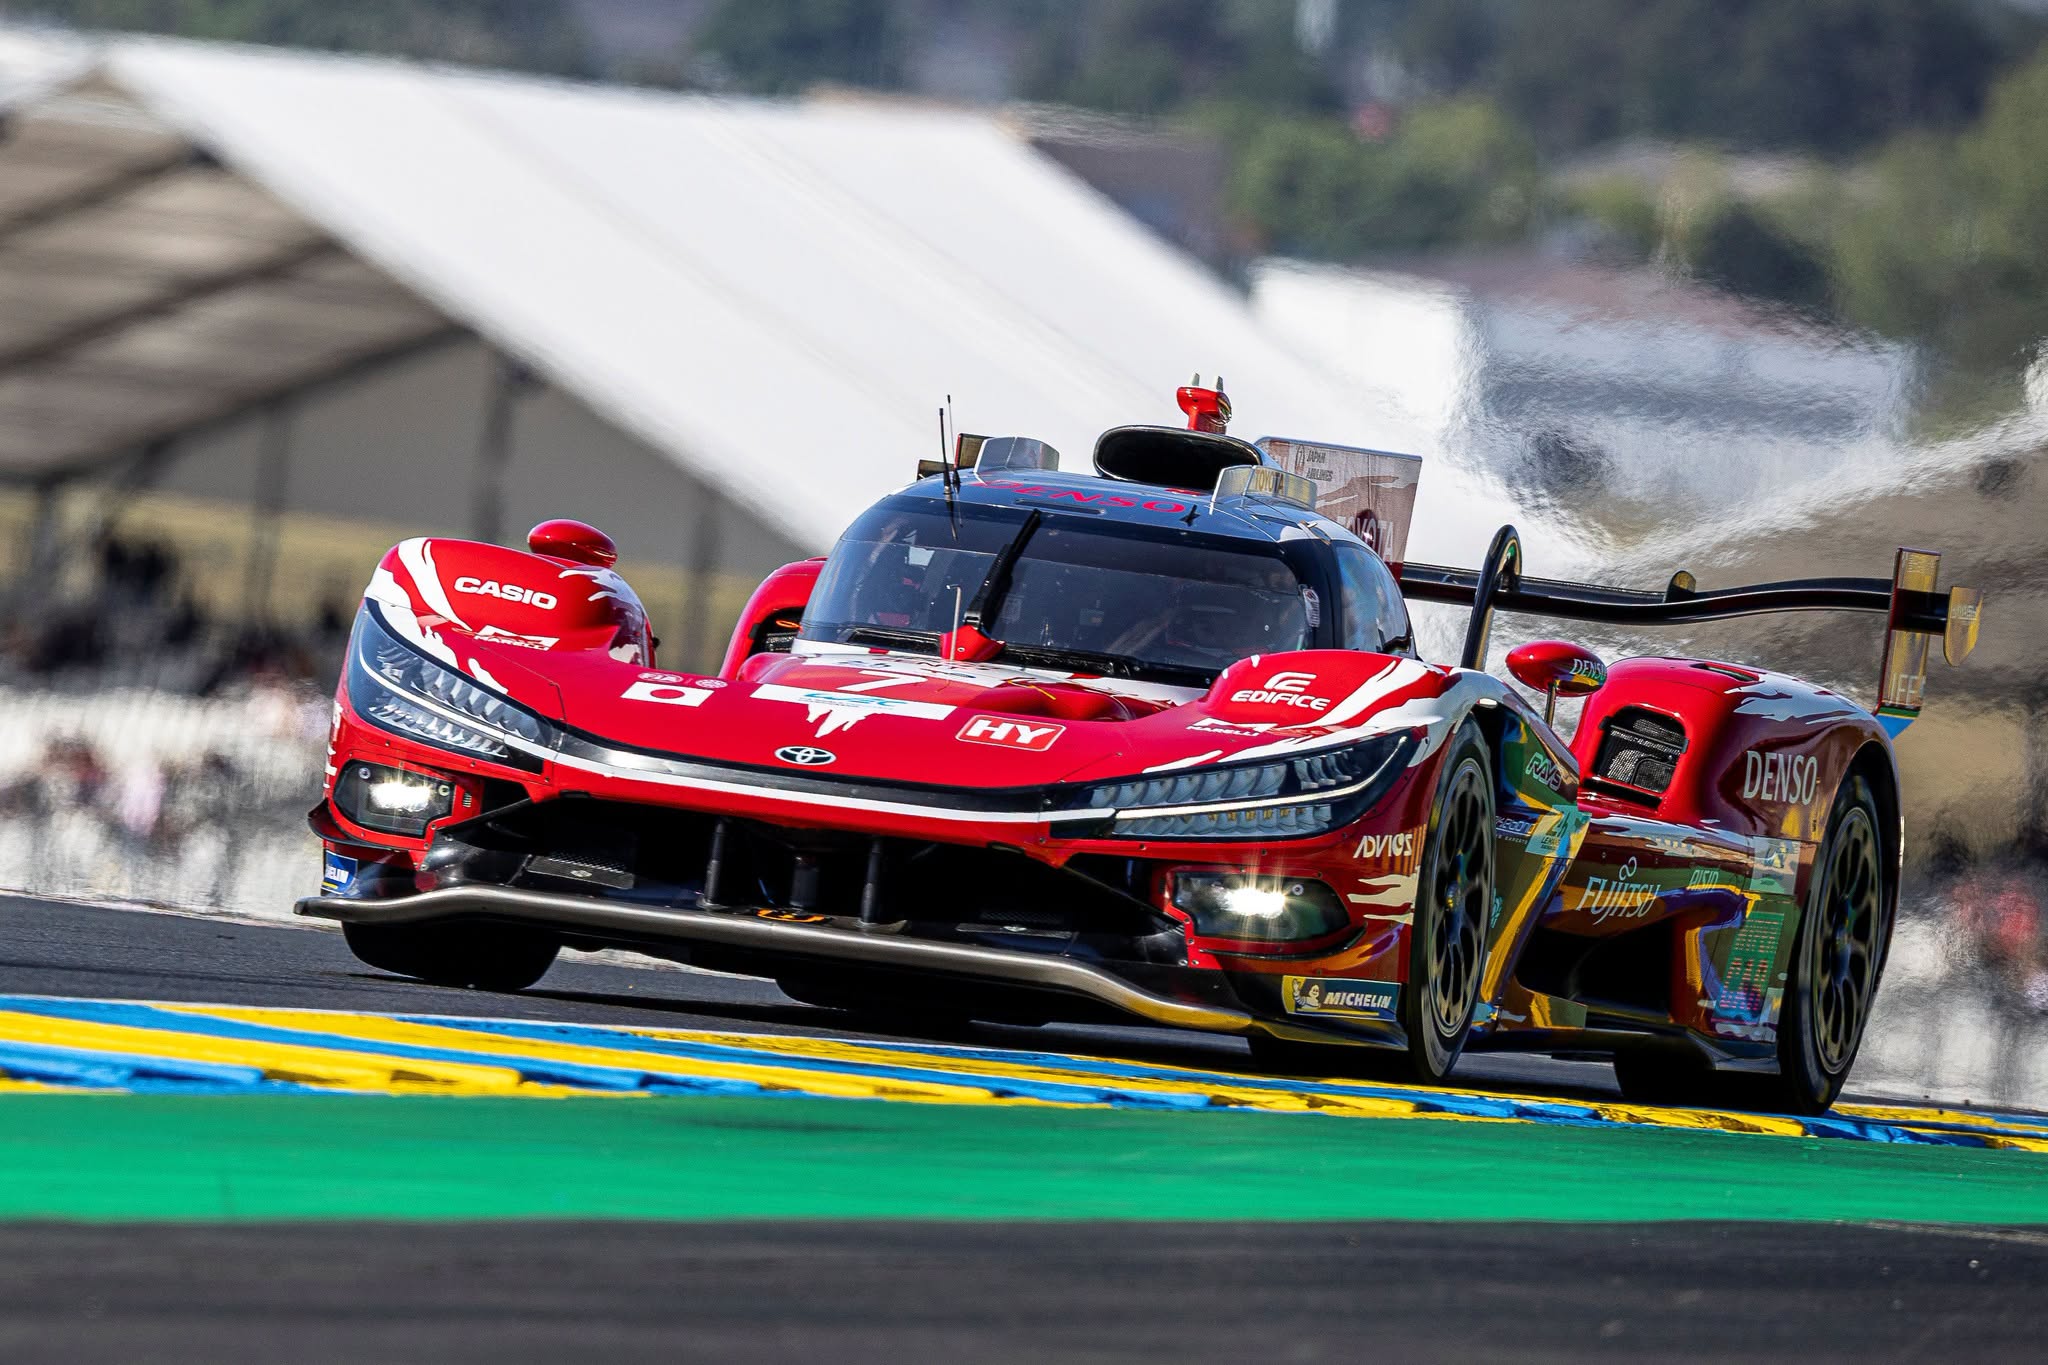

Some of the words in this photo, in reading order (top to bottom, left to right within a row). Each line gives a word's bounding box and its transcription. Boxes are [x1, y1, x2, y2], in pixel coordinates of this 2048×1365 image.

[1255, 469, 1285, 493] TOYOTA
[969, 480, 1188, 514] DENSO
[454, 576, 558, 610] CASIO
[836, 669, 928, 693] 7
[1230, 690, 1331, 711] EDIFICE
[966, 718, 1053, 745] HY
[1186, 725, 1261, 737] MARELLI
[1525, 752, 1562, 792] RAYS
[1743, 750, 1819, 806] DENSO
[1353, 833, 1414, 859] ADVICS
[1575, 876, 1662, 926] FUJITSU
[1323, 991, 1393, 1009] MICHELIN
